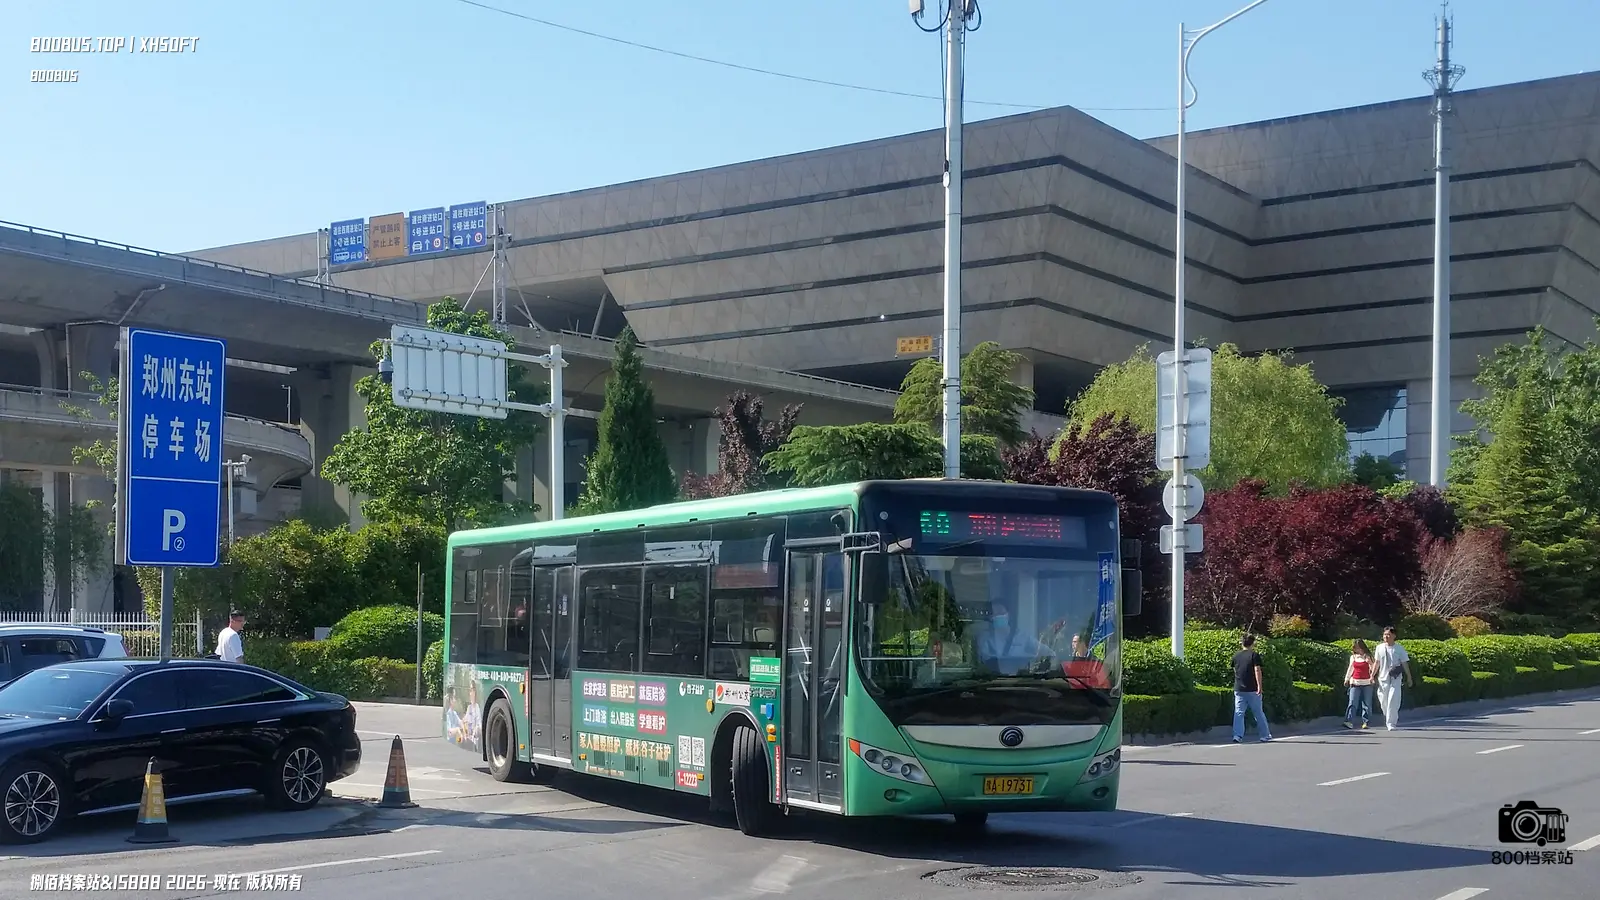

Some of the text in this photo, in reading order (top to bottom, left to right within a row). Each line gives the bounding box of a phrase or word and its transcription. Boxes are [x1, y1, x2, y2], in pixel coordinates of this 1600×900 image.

[412, 225, 443, 237] 5号进站口
[452, 219, 484, 231] 5号进站口
[141, 354, 213, 406] 郑州东站
[141, 413, 212, 463] 停车场
[610, 683, 635, 699] 医院护工
[639, 685, 666, 702] 就医陪诊
[583, 707, 607, 724] 上门助浴
[610, 710, 635, 727] 出入院接送
